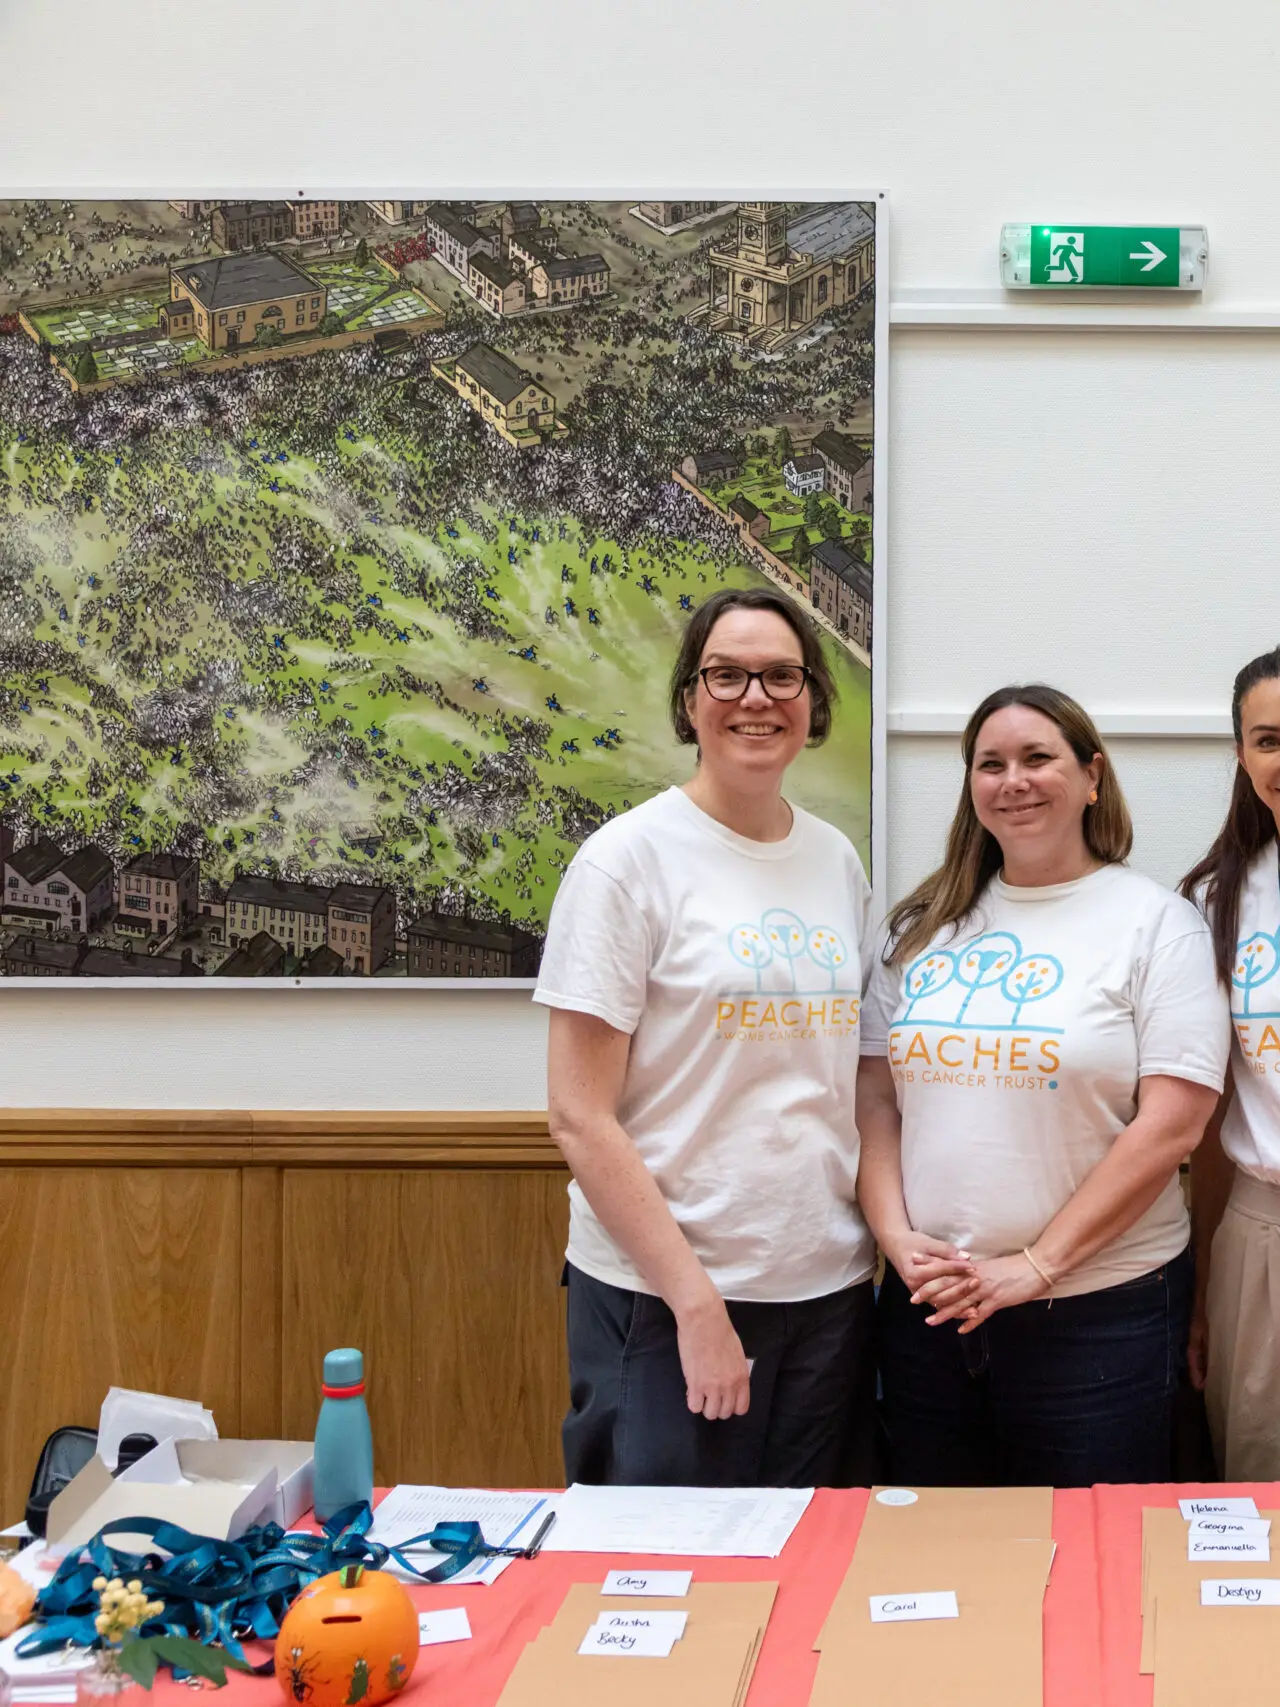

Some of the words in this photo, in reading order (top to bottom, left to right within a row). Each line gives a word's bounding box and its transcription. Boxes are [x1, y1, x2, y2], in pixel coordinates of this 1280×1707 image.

[716, 999, 860, 1029] PEACHES
[724, 1030, 764, 1042] WOMB
[769, 1029, 817, 1041] CANCER
[889, 1031, 1061, 1074] EACHES
[921, 1070, 987, 1087] CANCER
[993, 1075, 1049, 1090] TRUST
[1191, 1503, 1229, 1514] Helena
[1198, 1520, 1245, 1534] Georgina
[1193, 1542, 1257, 1552] Emmanuella
[1218, 1585, 1262, 1602] Destiny
[881, 1601, 917, 1613] Carol
[596, 1631, 637, 1650] Becky
